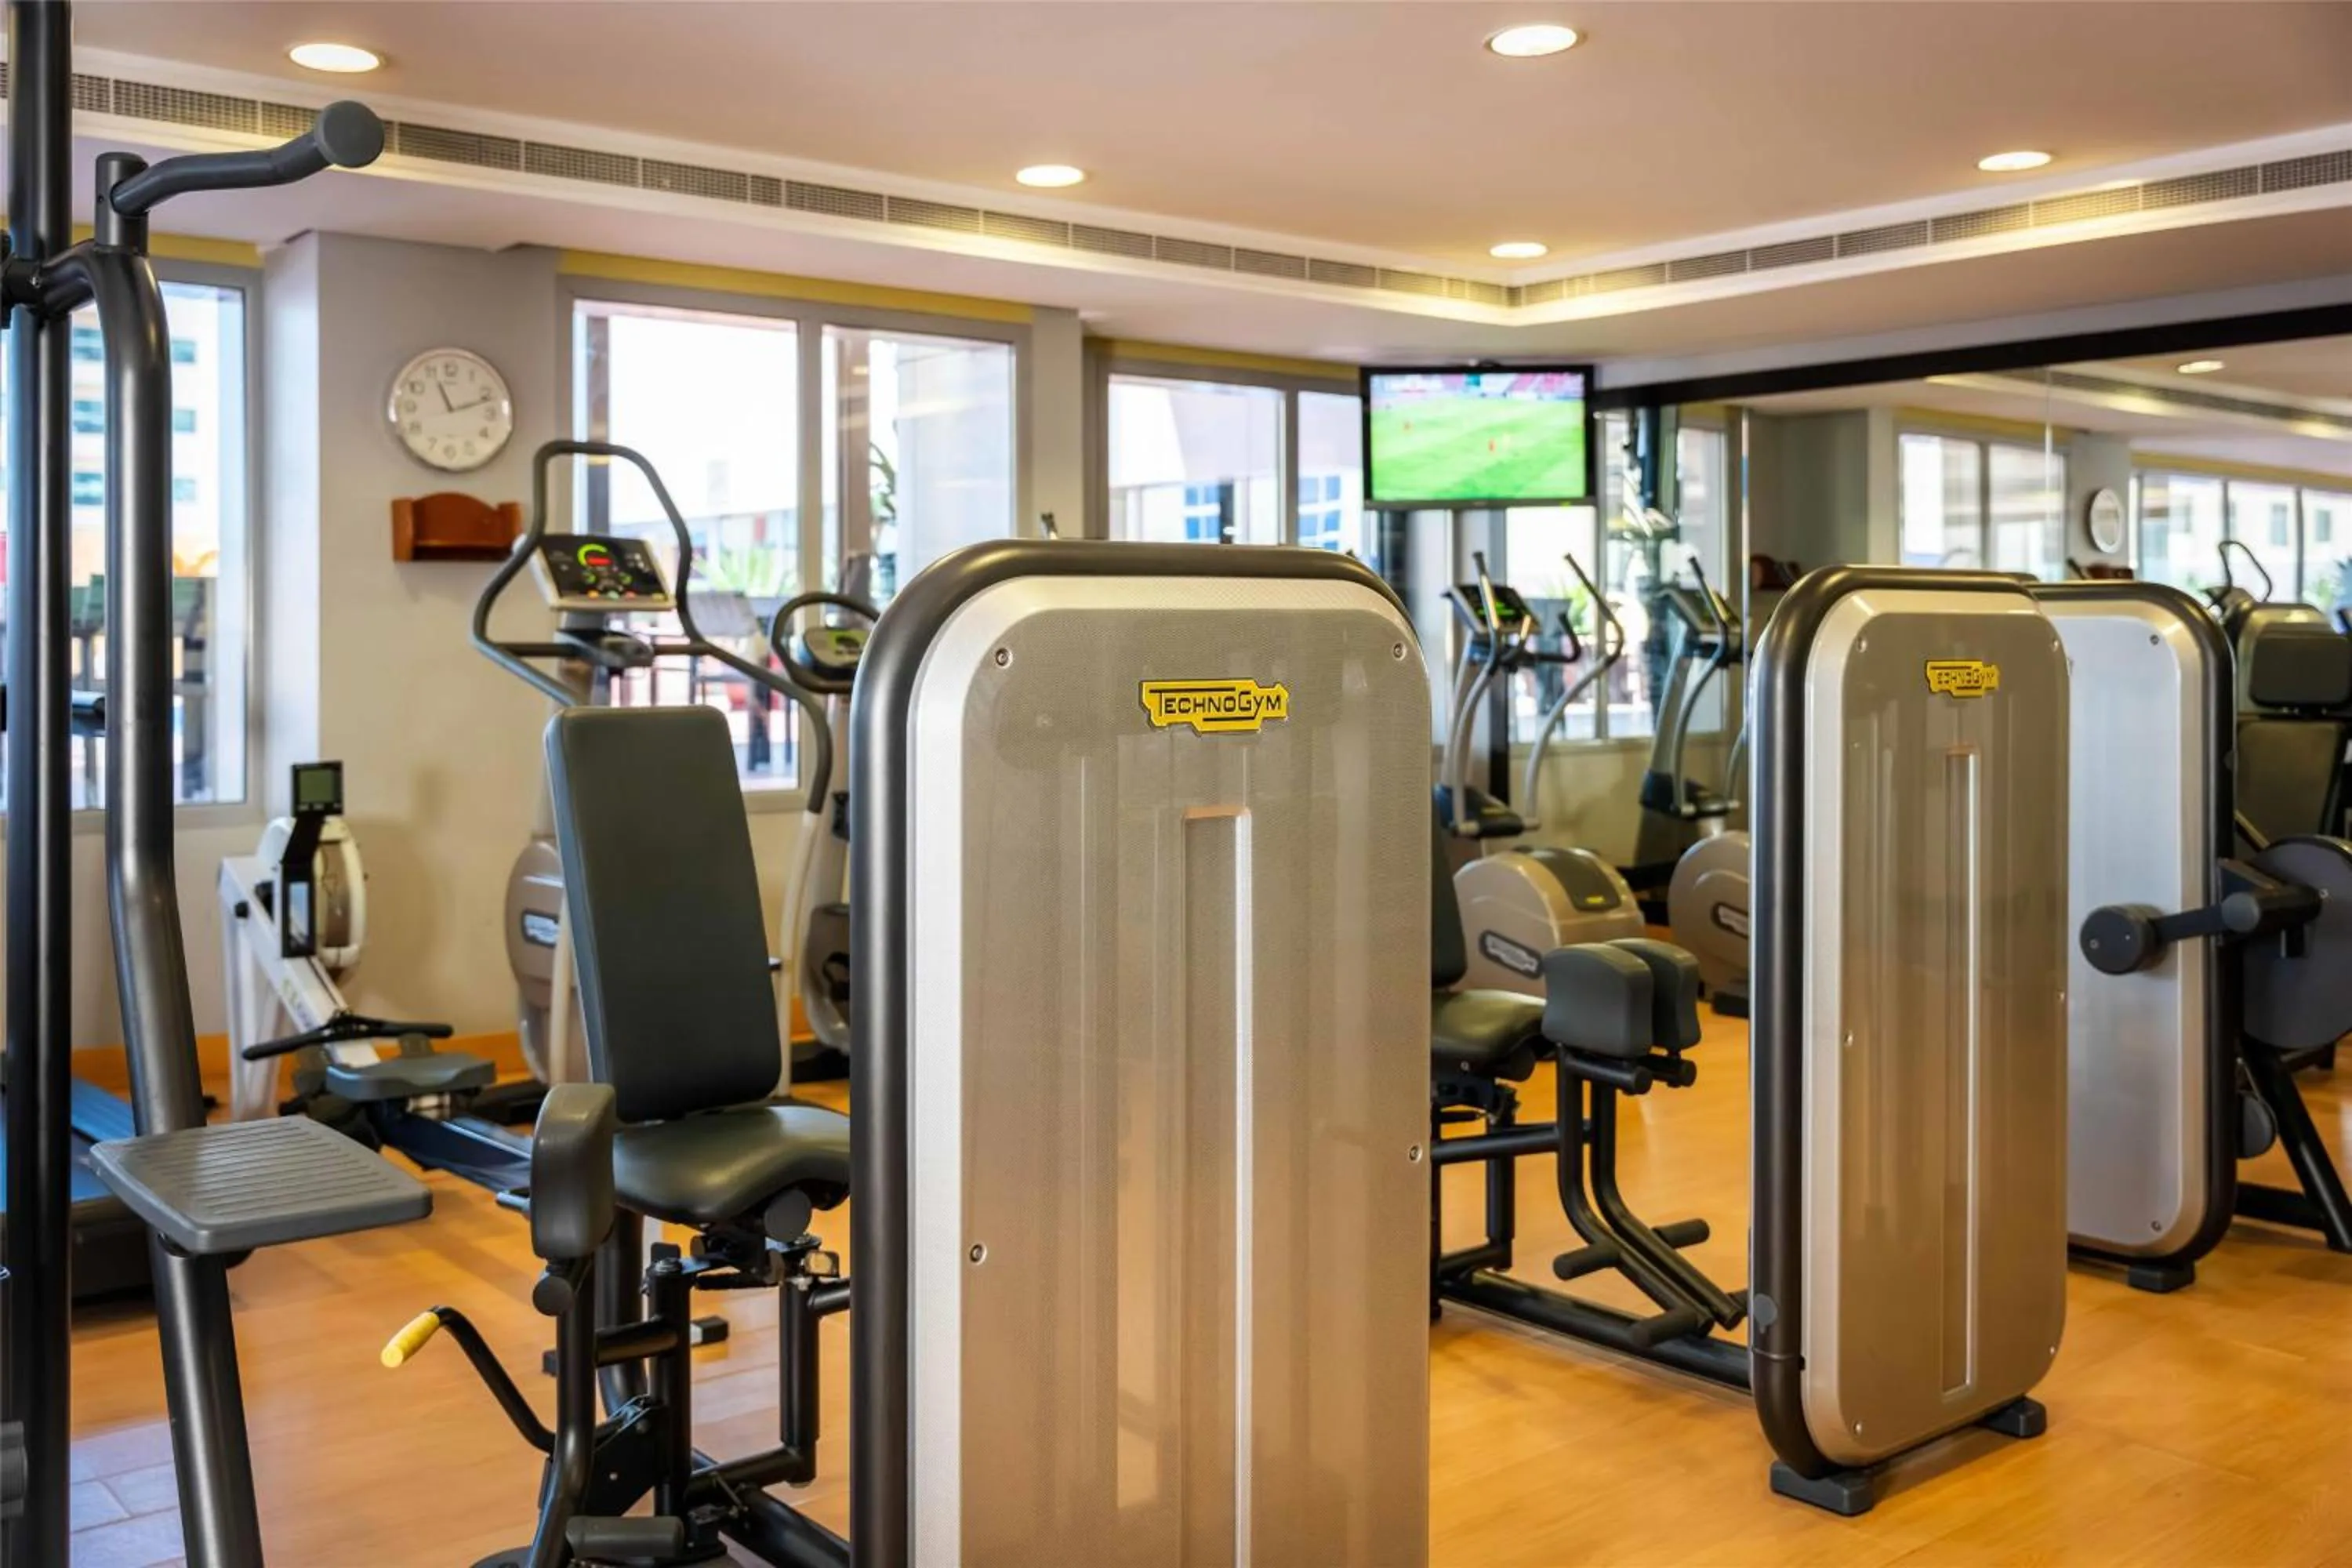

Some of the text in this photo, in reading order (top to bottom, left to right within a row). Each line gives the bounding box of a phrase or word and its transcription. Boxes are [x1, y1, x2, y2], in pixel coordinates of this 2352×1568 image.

[444, 361, 459, 378] 12
[408, 379, 425, 395] 10
[478, 426, 489, 439] 4
[427, 436, 438, 450] 7
